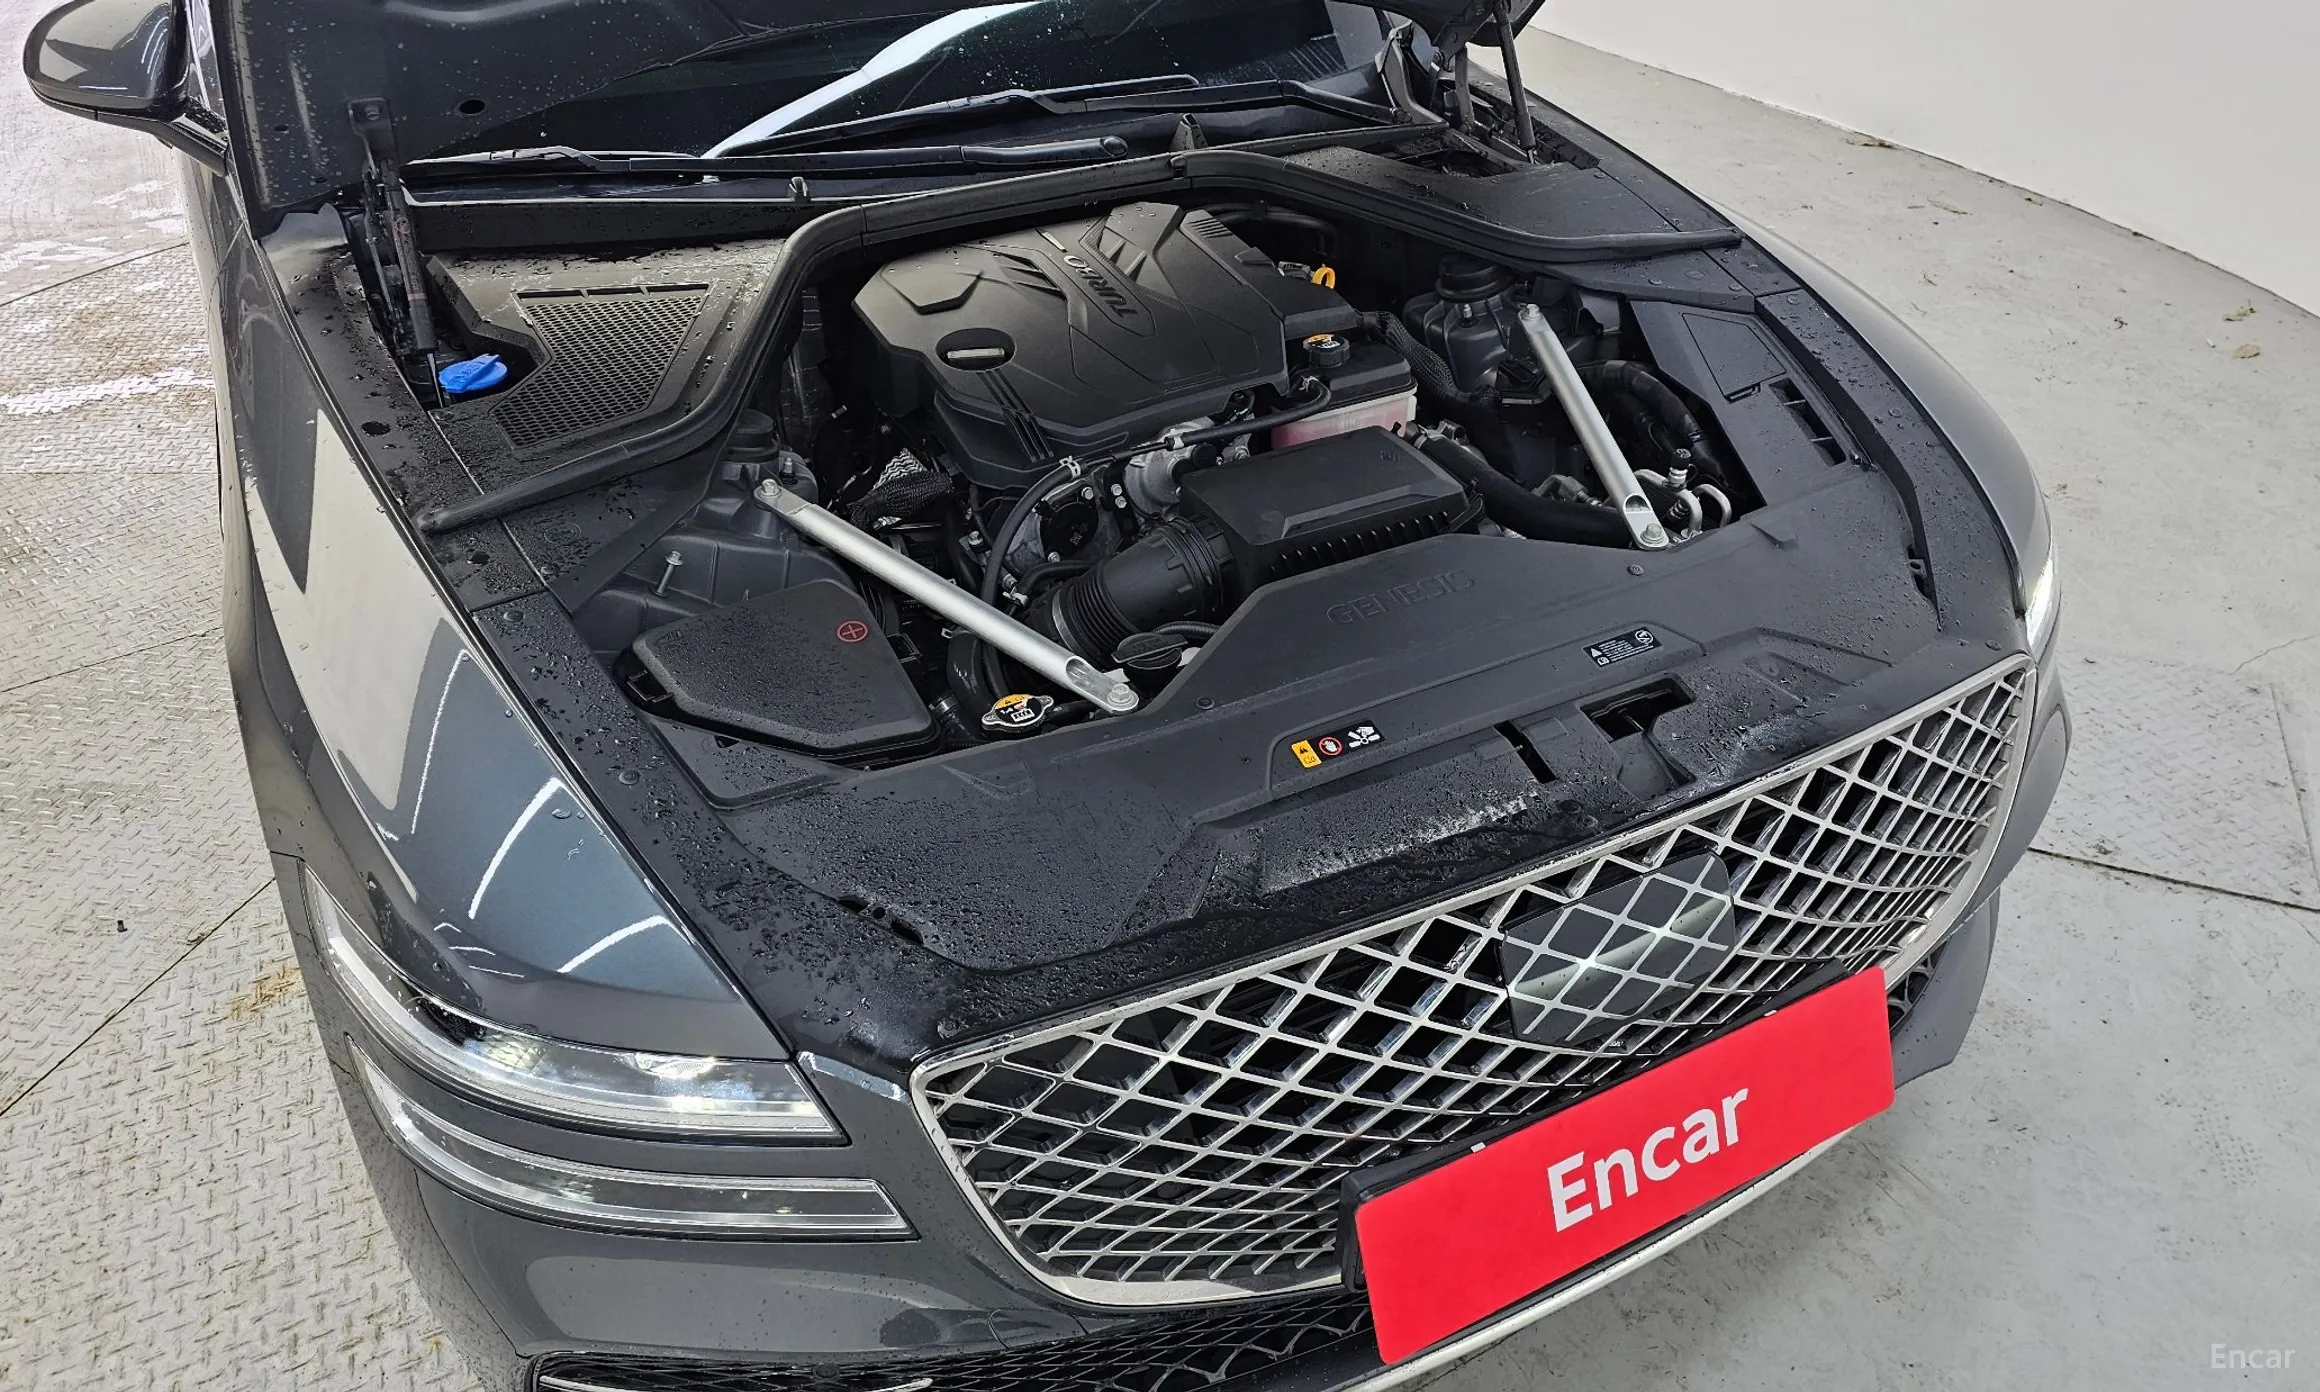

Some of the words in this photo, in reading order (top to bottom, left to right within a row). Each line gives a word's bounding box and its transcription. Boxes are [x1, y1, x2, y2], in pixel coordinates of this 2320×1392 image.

[1063, 255, 1138, 318] TURBO
[1326, 569, 1475, 624] GENESIS
[1547, 1088, 1749, 1232] Encar
